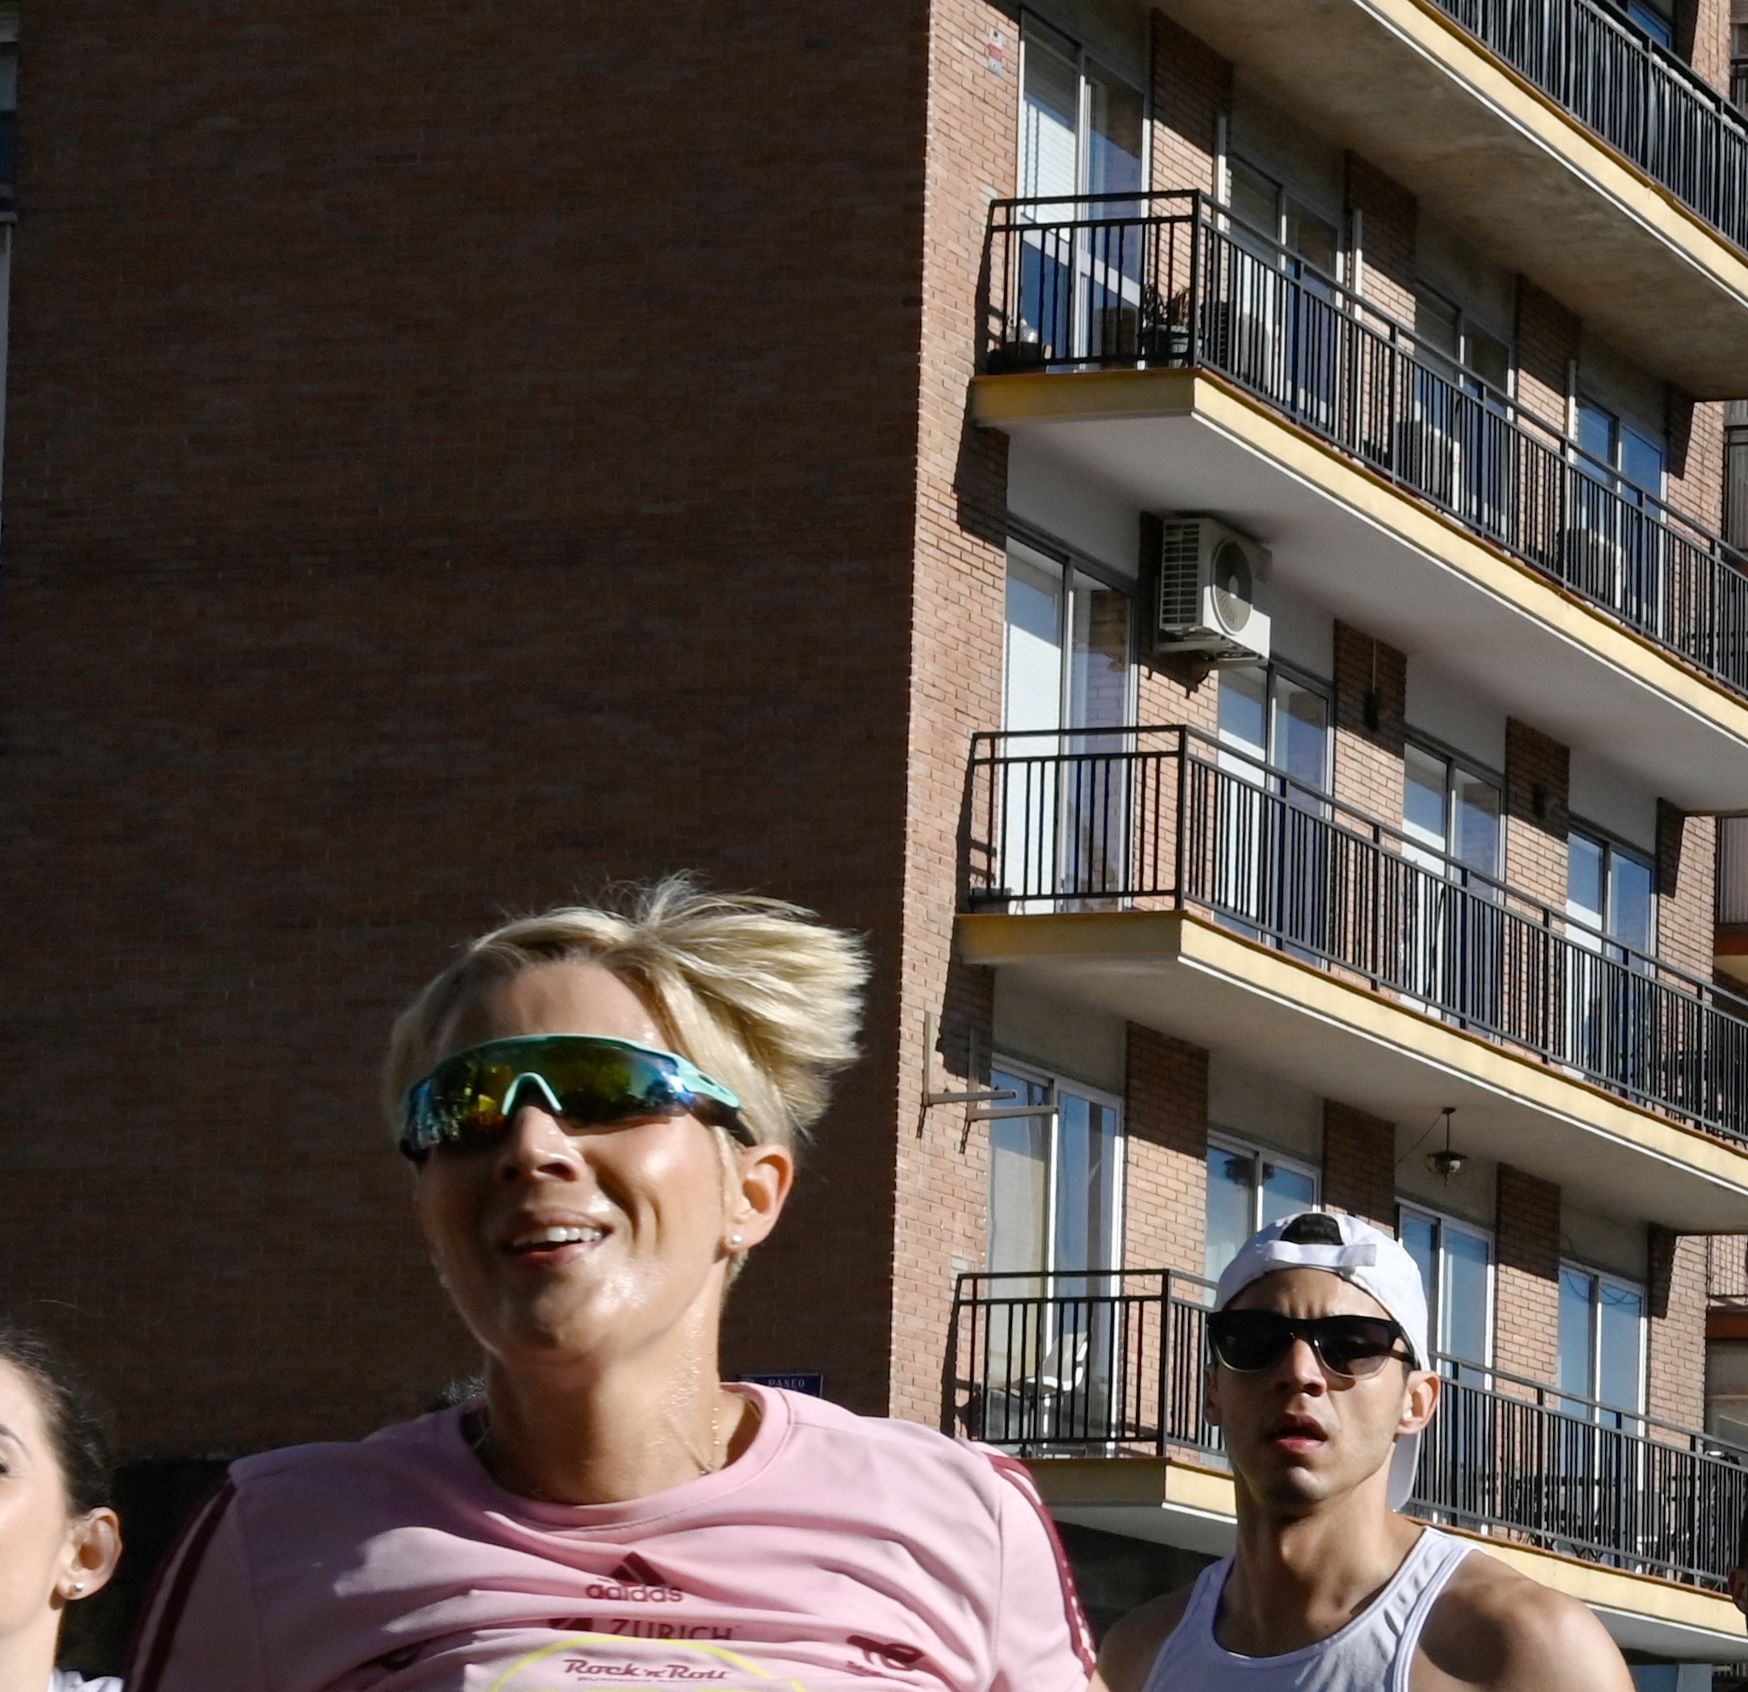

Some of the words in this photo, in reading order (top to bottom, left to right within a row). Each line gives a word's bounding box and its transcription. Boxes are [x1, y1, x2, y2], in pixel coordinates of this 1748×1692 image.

[768, 1378, 805, 1388] PASEO
[586, 1576, 684, 1604] adidas
[608, 1618, 733, 1641] ZURICH
[563, 1657, 637, 1677] Rock
